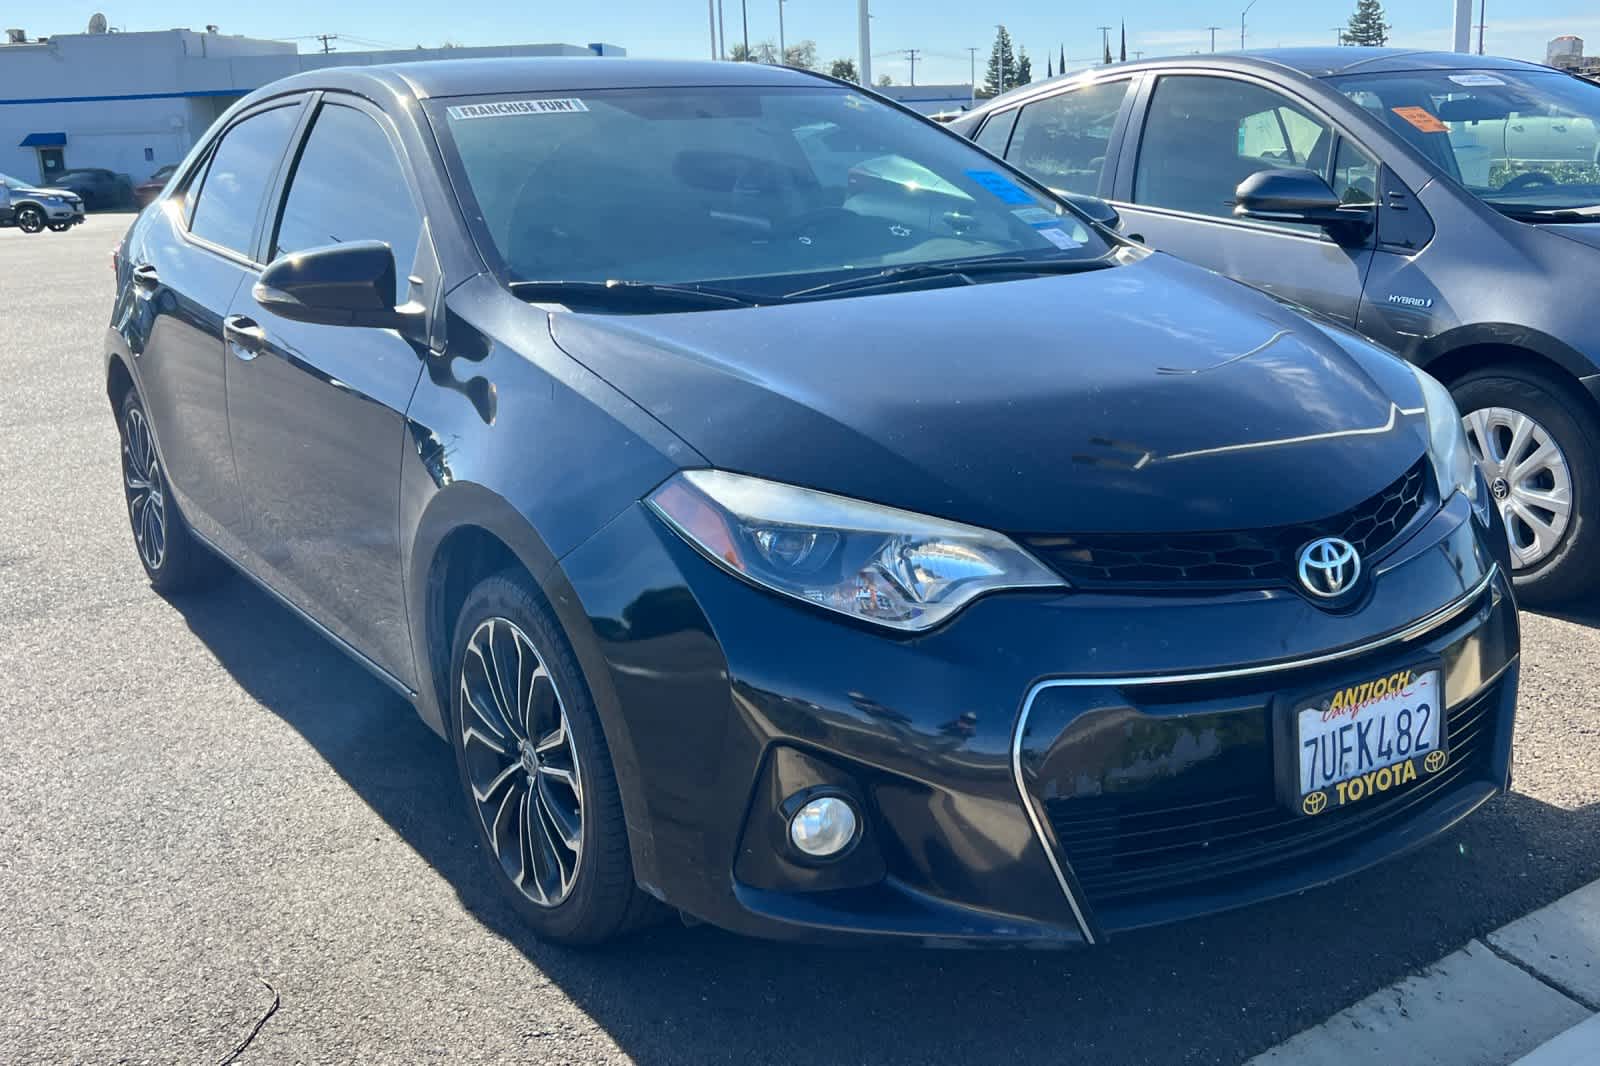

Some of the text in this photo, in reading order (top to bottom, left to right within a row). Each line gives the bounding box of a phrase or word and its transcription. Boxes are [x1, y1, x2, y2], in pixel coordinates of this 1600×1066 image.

[460, 99, 574, 117] FRANCHISE FURY
[1389, 294, 1425, 307] HYBRID
[1329, 669, 1411, 713] ANTIOCH
[1303, 703, 1431, 789] 7UFK482
[1336, 759, 1416, 805] TOYOTA
